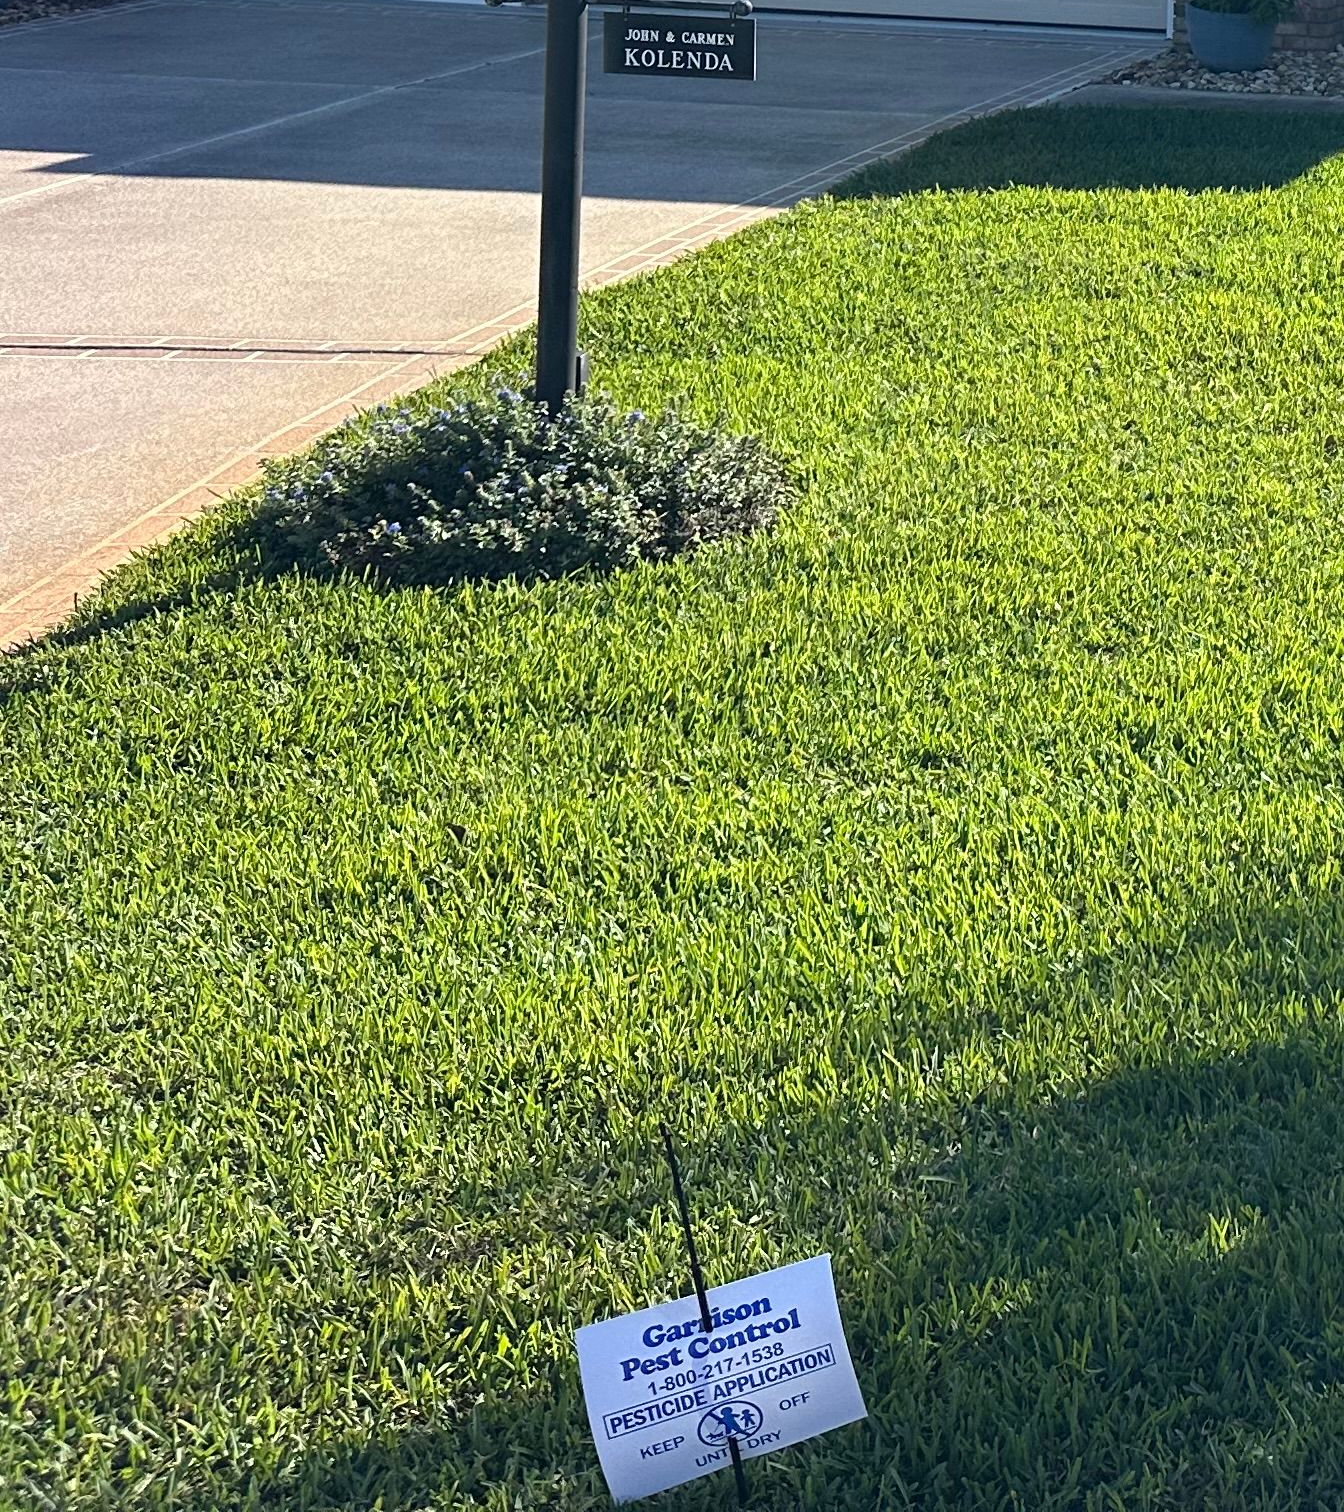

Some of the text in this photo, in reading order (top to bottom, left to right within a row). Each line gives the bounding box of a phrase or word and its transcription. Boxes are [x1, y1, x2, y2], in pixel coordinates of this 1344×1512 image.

[624, 48, 734, 71] KOLENDA
[625, 28, 735, 46] JOHN & CARMEN
[620, 1308, 801, 1381] Pest Control
[648, 1342, 784, 1395] 1-800-217-1538
[609, 1349, 832, 1434] PESTICIDE APPLICATION
[640, 1391, 811, 1459] KEEP OFF
[696, 1430, 782, 1467] UNT DRY
